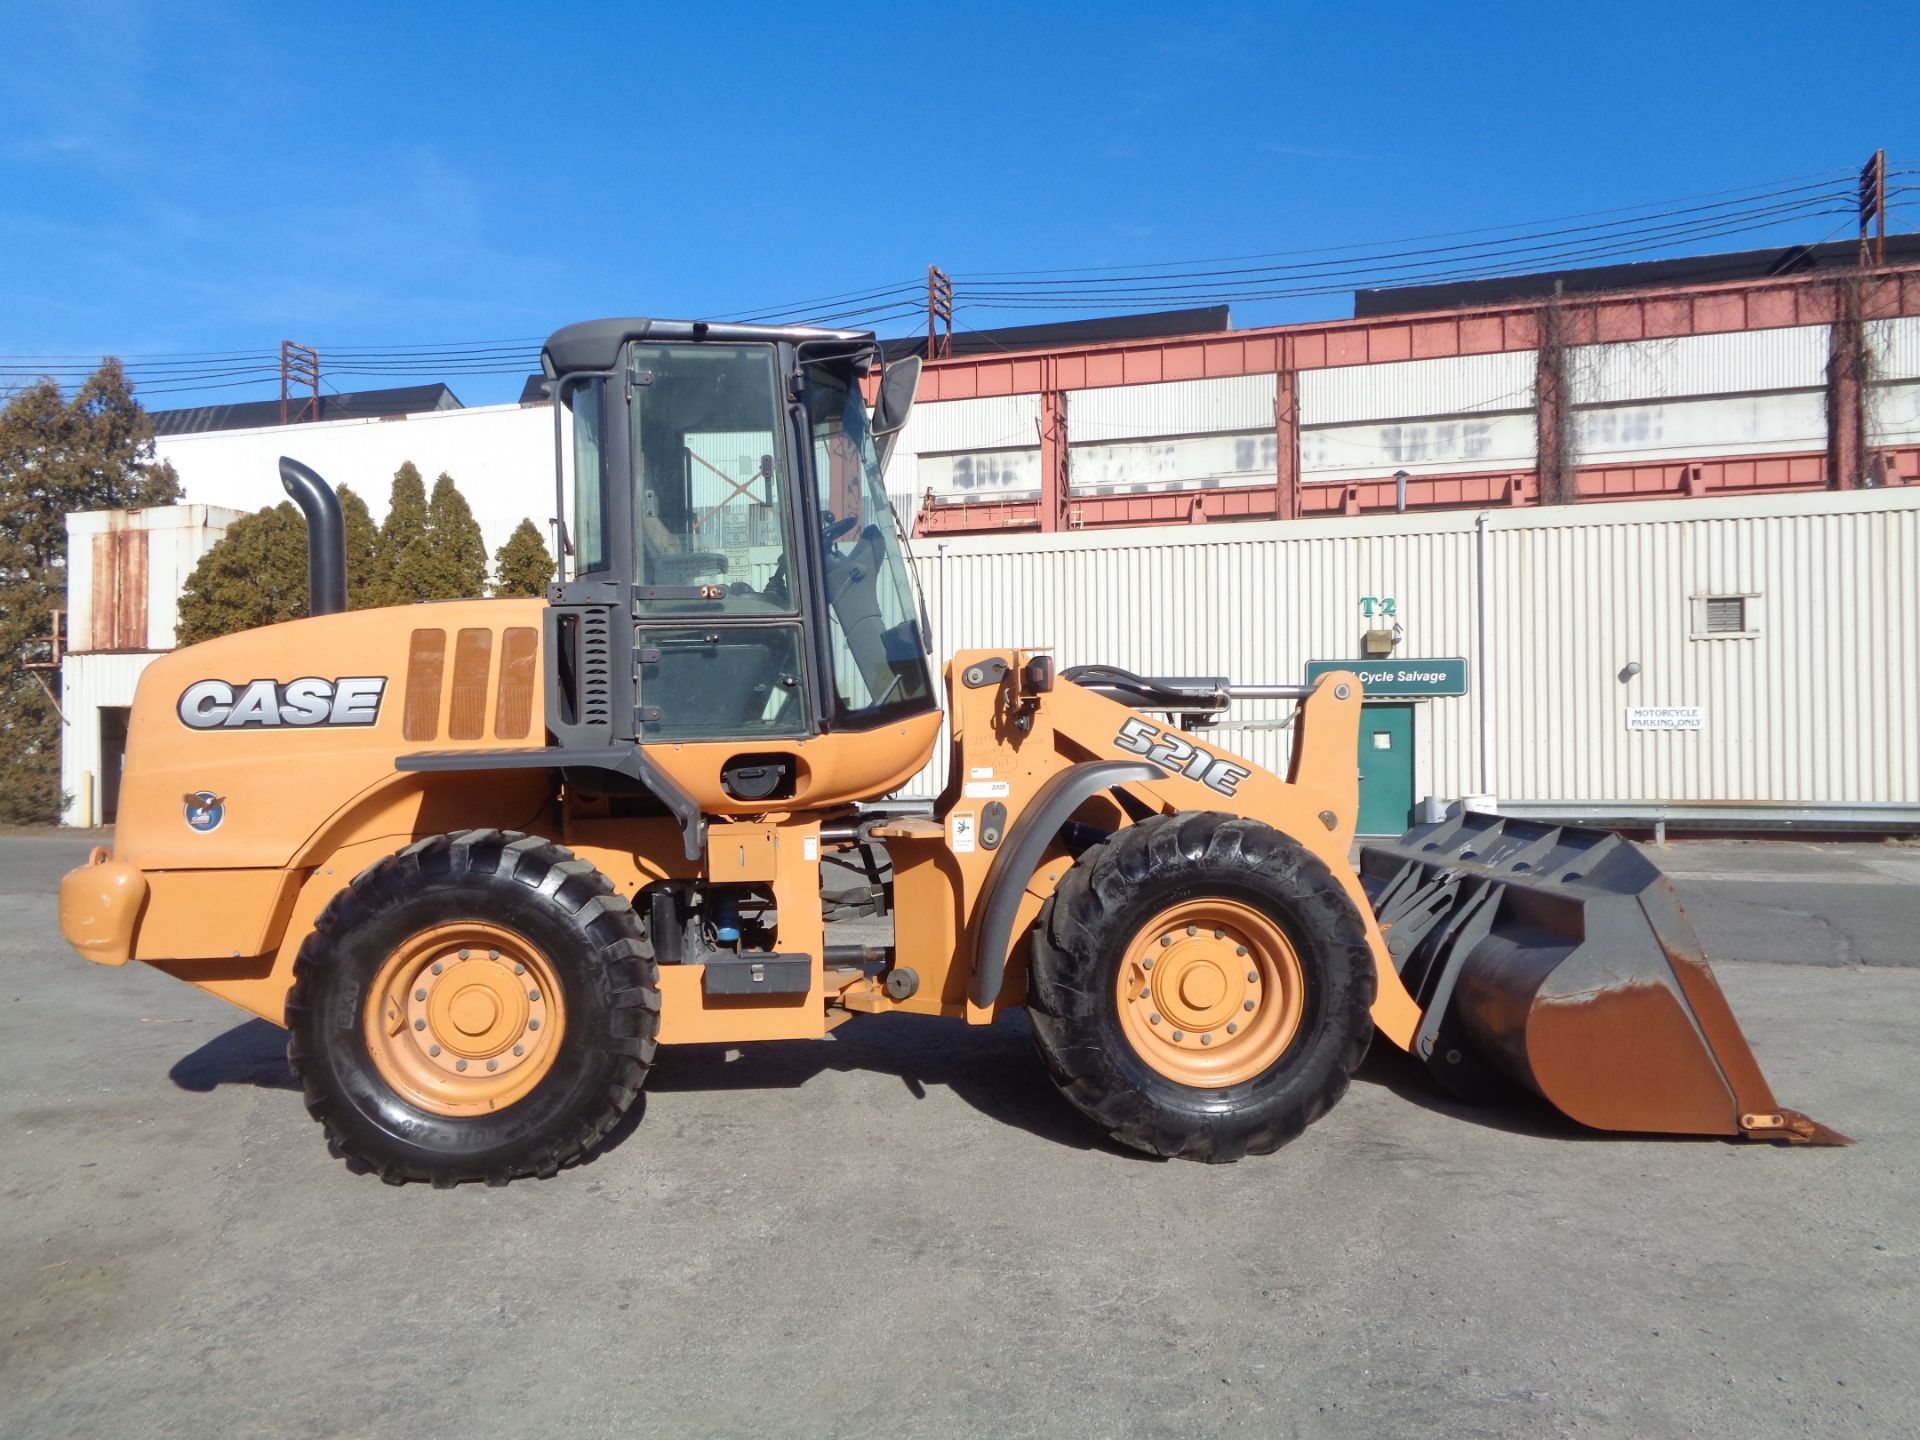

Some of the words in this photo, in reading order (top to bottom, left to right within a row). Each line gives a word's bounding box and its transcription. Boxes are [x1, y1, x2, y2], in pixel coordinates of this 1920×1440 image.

[1360, 597, 1396, 616] T2
[1359, 671, 1394, 685] Cycle
[1397, 670, 1447, 684] Salvage
[179, 677, 384, 728] CASE
[1634, 709, 1699, 718] MOTORCYCLE
[1631, 719, 1674, 727] PARKING
[1677, 719, 1702, 727] ONLY
[1114, 716, 1252, 798] 521E
